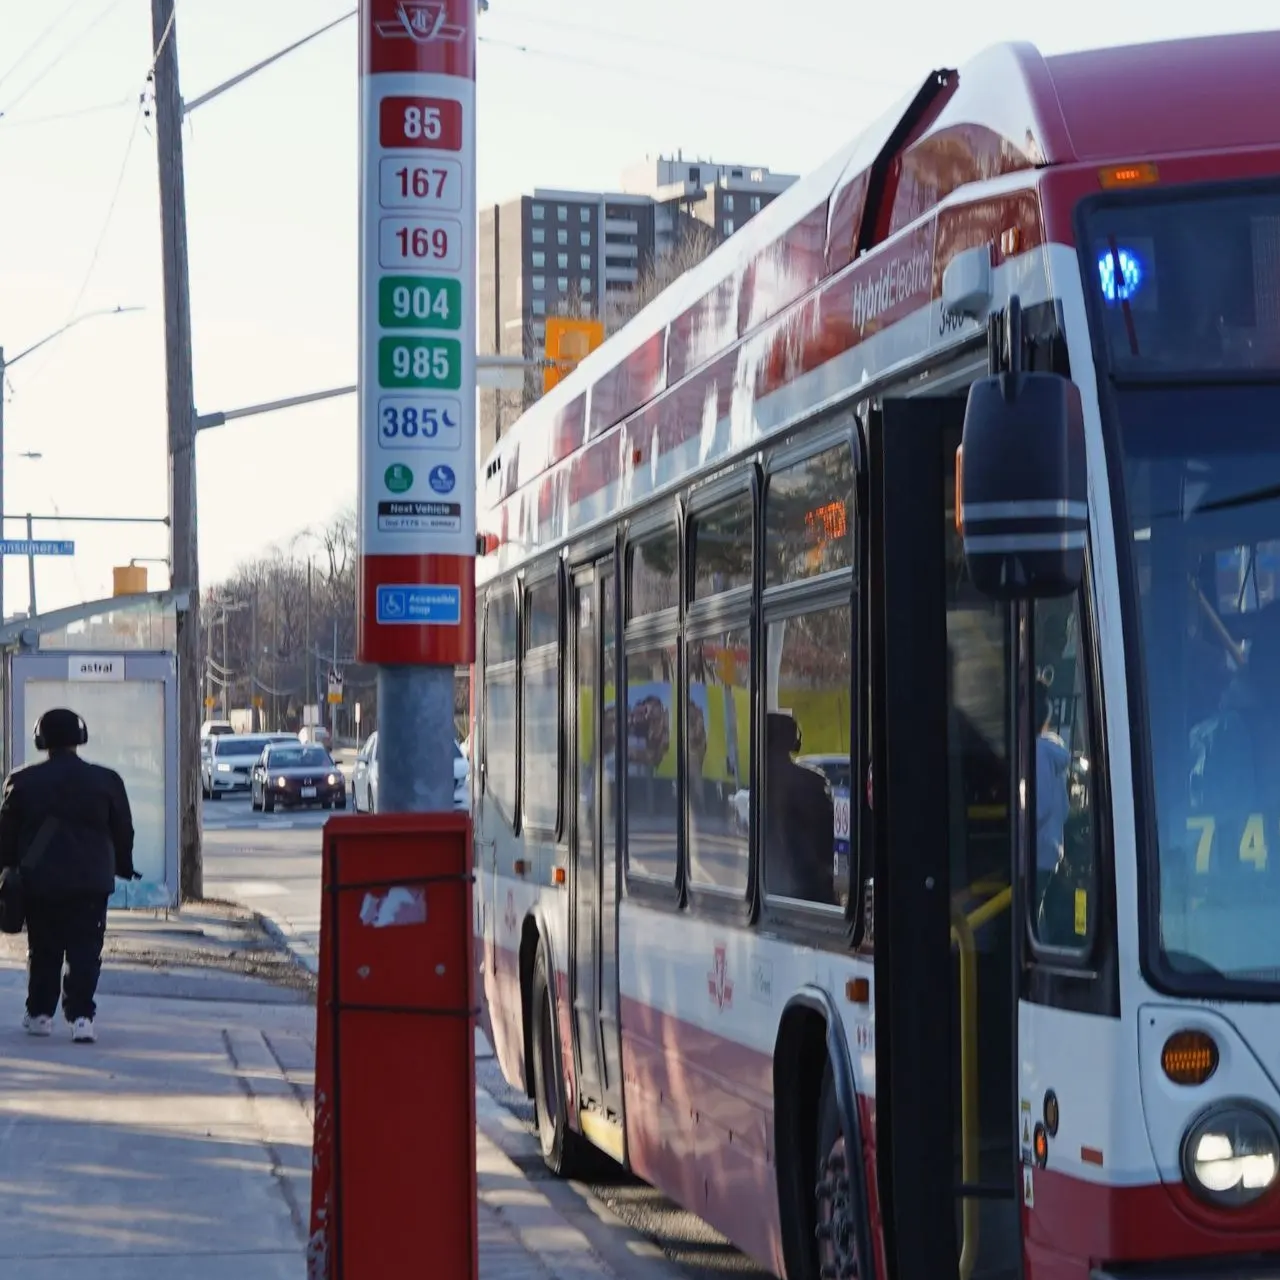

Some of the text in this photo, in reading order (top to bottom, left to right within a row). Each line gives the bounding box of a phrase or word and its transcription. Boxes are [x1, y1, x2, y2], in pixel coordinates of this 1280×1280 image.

[403, 106, 441, 139] 85
[395, 168, 447, 198] 167
[395, 228, 447, 258] 169
[393, 286, 449, 319] 904
[852, 249, 929, 336] HybridElectric
[393, 346, 449, 379] 985
[382, 407, 439, 439] 385
[390, 503, 450, 515] Next Vehicle
[409, 593, 456, 605] Accessible
[409, 605, 431, 616] Stop
[80, 663, 113, 673] astral
